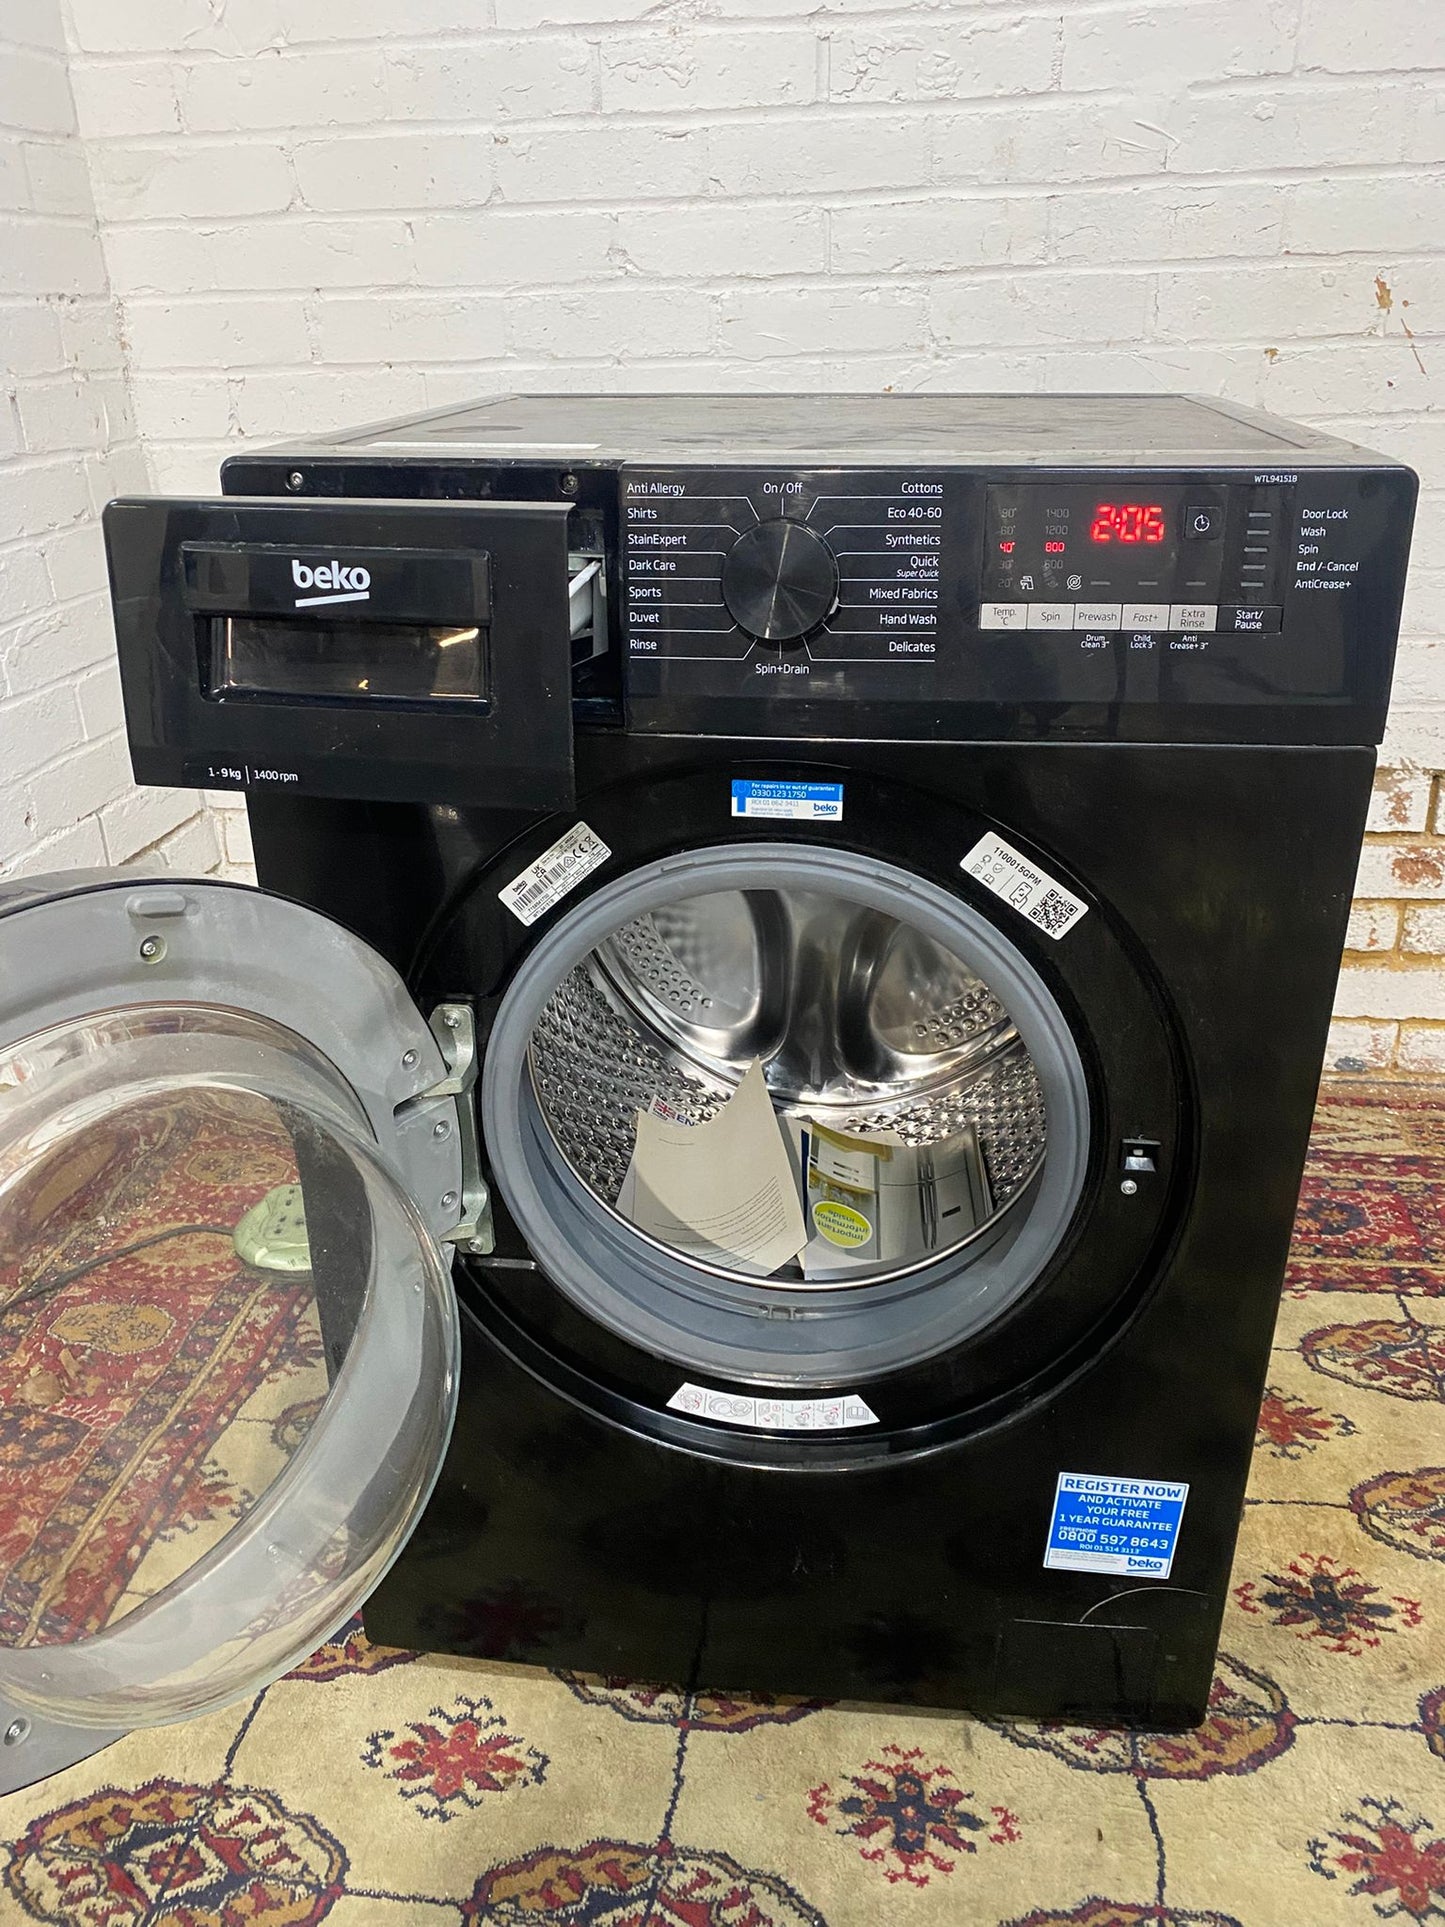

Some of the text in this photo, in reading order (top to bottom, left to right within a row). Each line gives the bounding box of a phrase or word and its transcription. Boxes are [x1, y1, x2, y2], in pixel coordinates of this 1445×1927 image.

[627, 483, 685, 496] Anti Allergy
[763, 483, 778, 494] On
[786, 482, 803, 494] Off
[902, 483, 943, 494] Cottons
[627, 508, 658, 519] Shirts
[888, 507, 942, 518] Eco 40-60
[1302, 509, 1349, 519] Door Lock
[1091, 505, 1165, 542] 2:05
[1045, 525, 1068, 535] 1200
[1301, 527, 1326, 536] Wash
[628, 534, 686, 546] StainExpert
[886, 534, 941, 546] Synthetics
[1045, 542, 1065, 552] 800
[1298, 544, 1319, 555] Spin
[629, 560, 676, 571] Dark Care
[910, 556, 939, 568] Quick
[1296, 562, 1316, 571] End
[1327, 562, 1359, 572] Cancel
[292, 560, 371, 591] beko
[897, 569, 940, 578] Super Quick
[1295, 579, 1351, 590] AntiCrease+
[629, 587, 662, 599] Sports
[870, 588, 938, 599] Mixed Fabrics
[993, 607, 1016, 617] Temp.
[1041, 612, 1060, 622] Spin
[1079, 612, 1117, 622] Prewash
[1133, 613, 1158, 622] Fast+
[1181, 609, 1206, 618] Extra
[1236, 610, 1264, 620] Start/
[629, 613, 660, 623] Duvet
[880, 614, 937, 625] Hand Wash
[1180, 618, 1204, 628] Rinse
[1234, 620, 1262, 630] Pause
[1085, 634, 1106, 642] Drum
[1133, 634, 1151, 642] Child
[630, 640, 657, 650] Rinse
[889, 641, 936, 652] Delicates
[1080, 641, 1100, 649] Clean
[1130, 641, 1146, 649] Lock
[755, 663, 810, 676] Spin+Drain
[254, 770, 298, 782] 1400 rpm
[751, 789, 806, 798] 0330 123 1750
[813, 803, 838, 812] beko
[993, 846, 1042, 886] 1100015GPM
[828, 1209, 855, 1223] inside
[815, 1211, 869, 1233] information
[816, 1220, 864, 1241] Important
[1065, 1478, 1181, 1498] REGISTER NOW
[1078, 1494, 1162, 1510] AND ACTIVATE
[1087, 1506, 1150, 1519] YOUR FREE
[1059, 1514, 1173, 1532] 1 YEAR GUARANTEE
[1058, 1530, 1168, 1550] 0800 597 8643
[1080, 1543, 1093, 1551] ROI
[1127, 1557, 1163, 1569] beko
